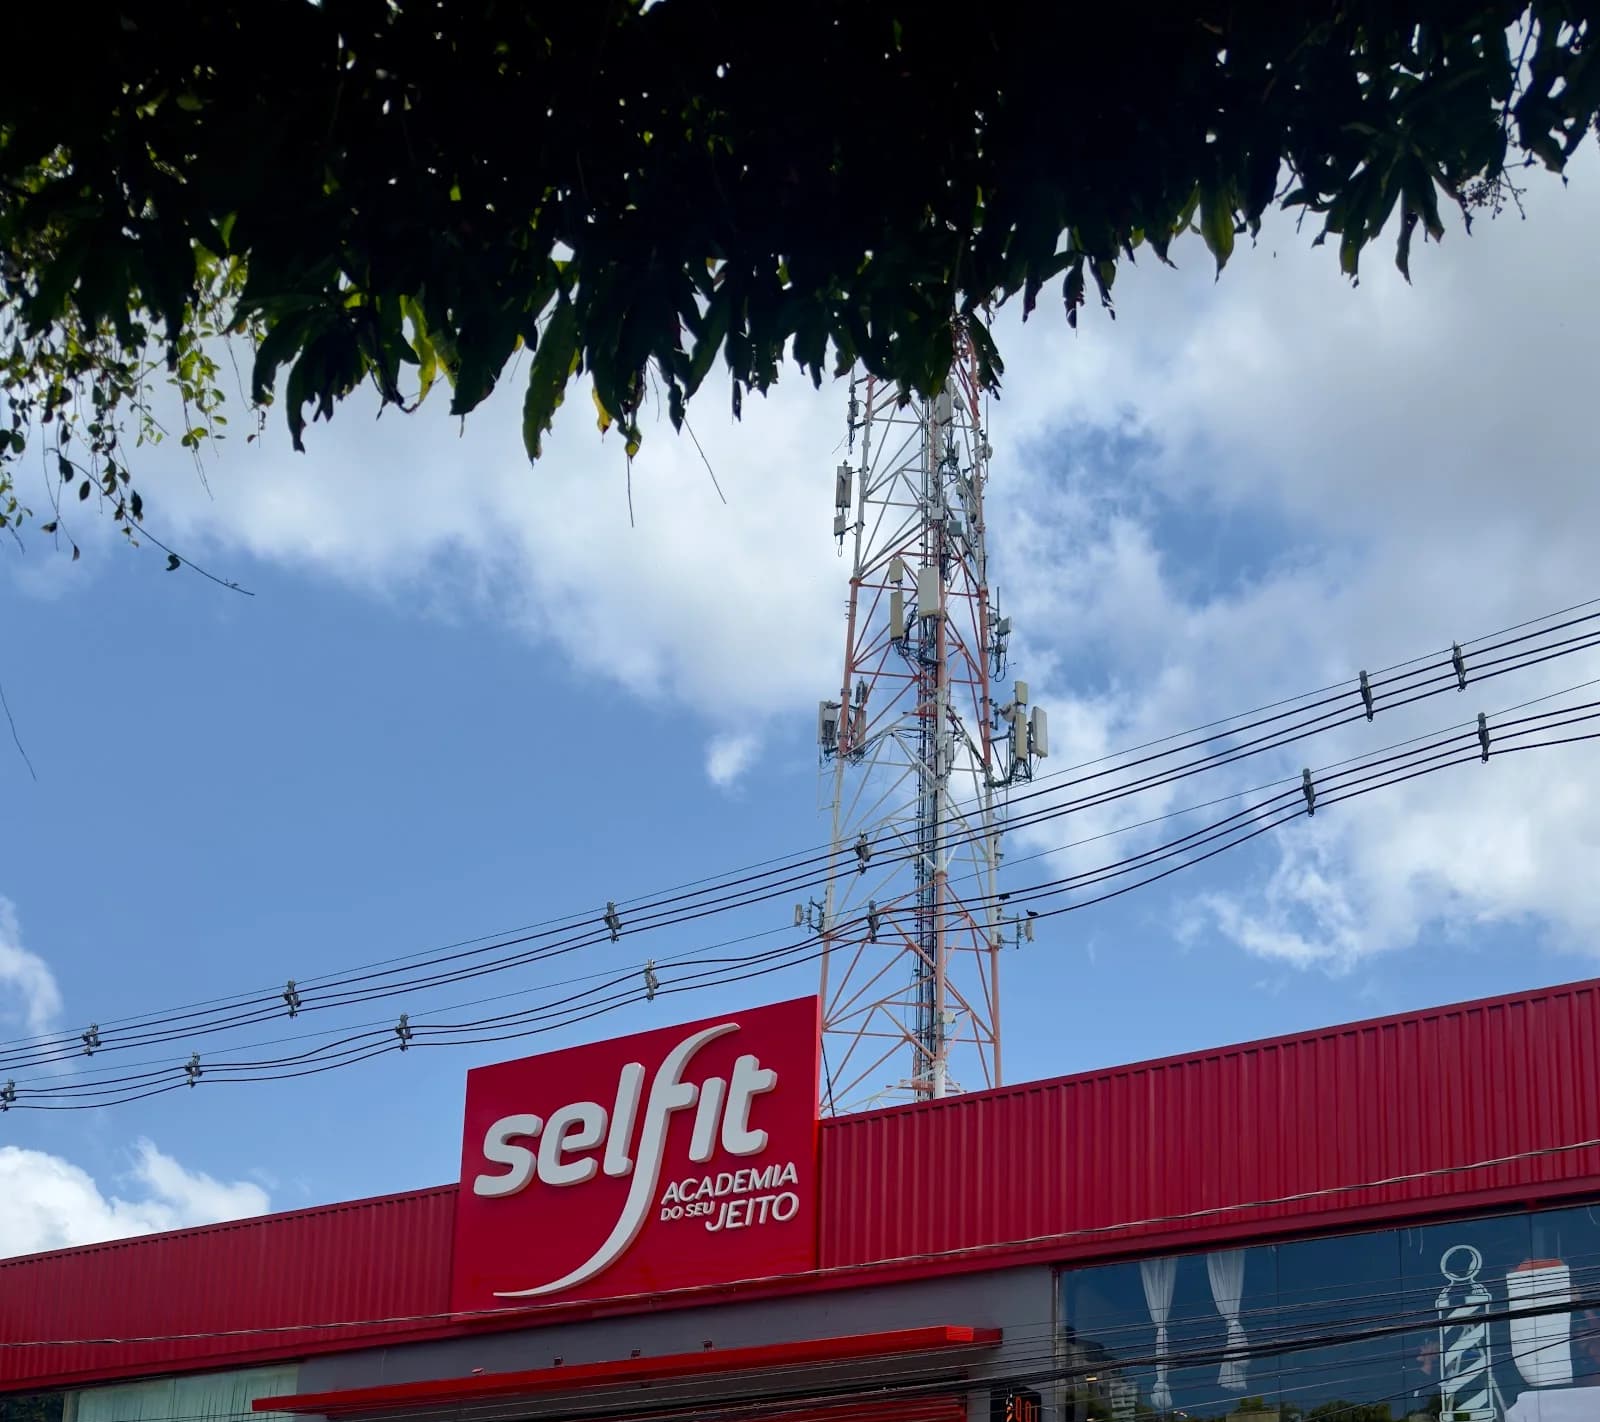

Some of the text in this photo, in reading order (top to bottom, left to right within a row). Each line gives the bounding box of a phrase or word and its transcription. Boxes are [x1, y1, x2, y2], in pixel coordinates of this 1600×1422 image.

[473, 1022, 778, 1297] selfit
[661, 1161, 799, 1205] ACADEMIA
[660, 1191, 800, 1232] DO SEU JEITO
